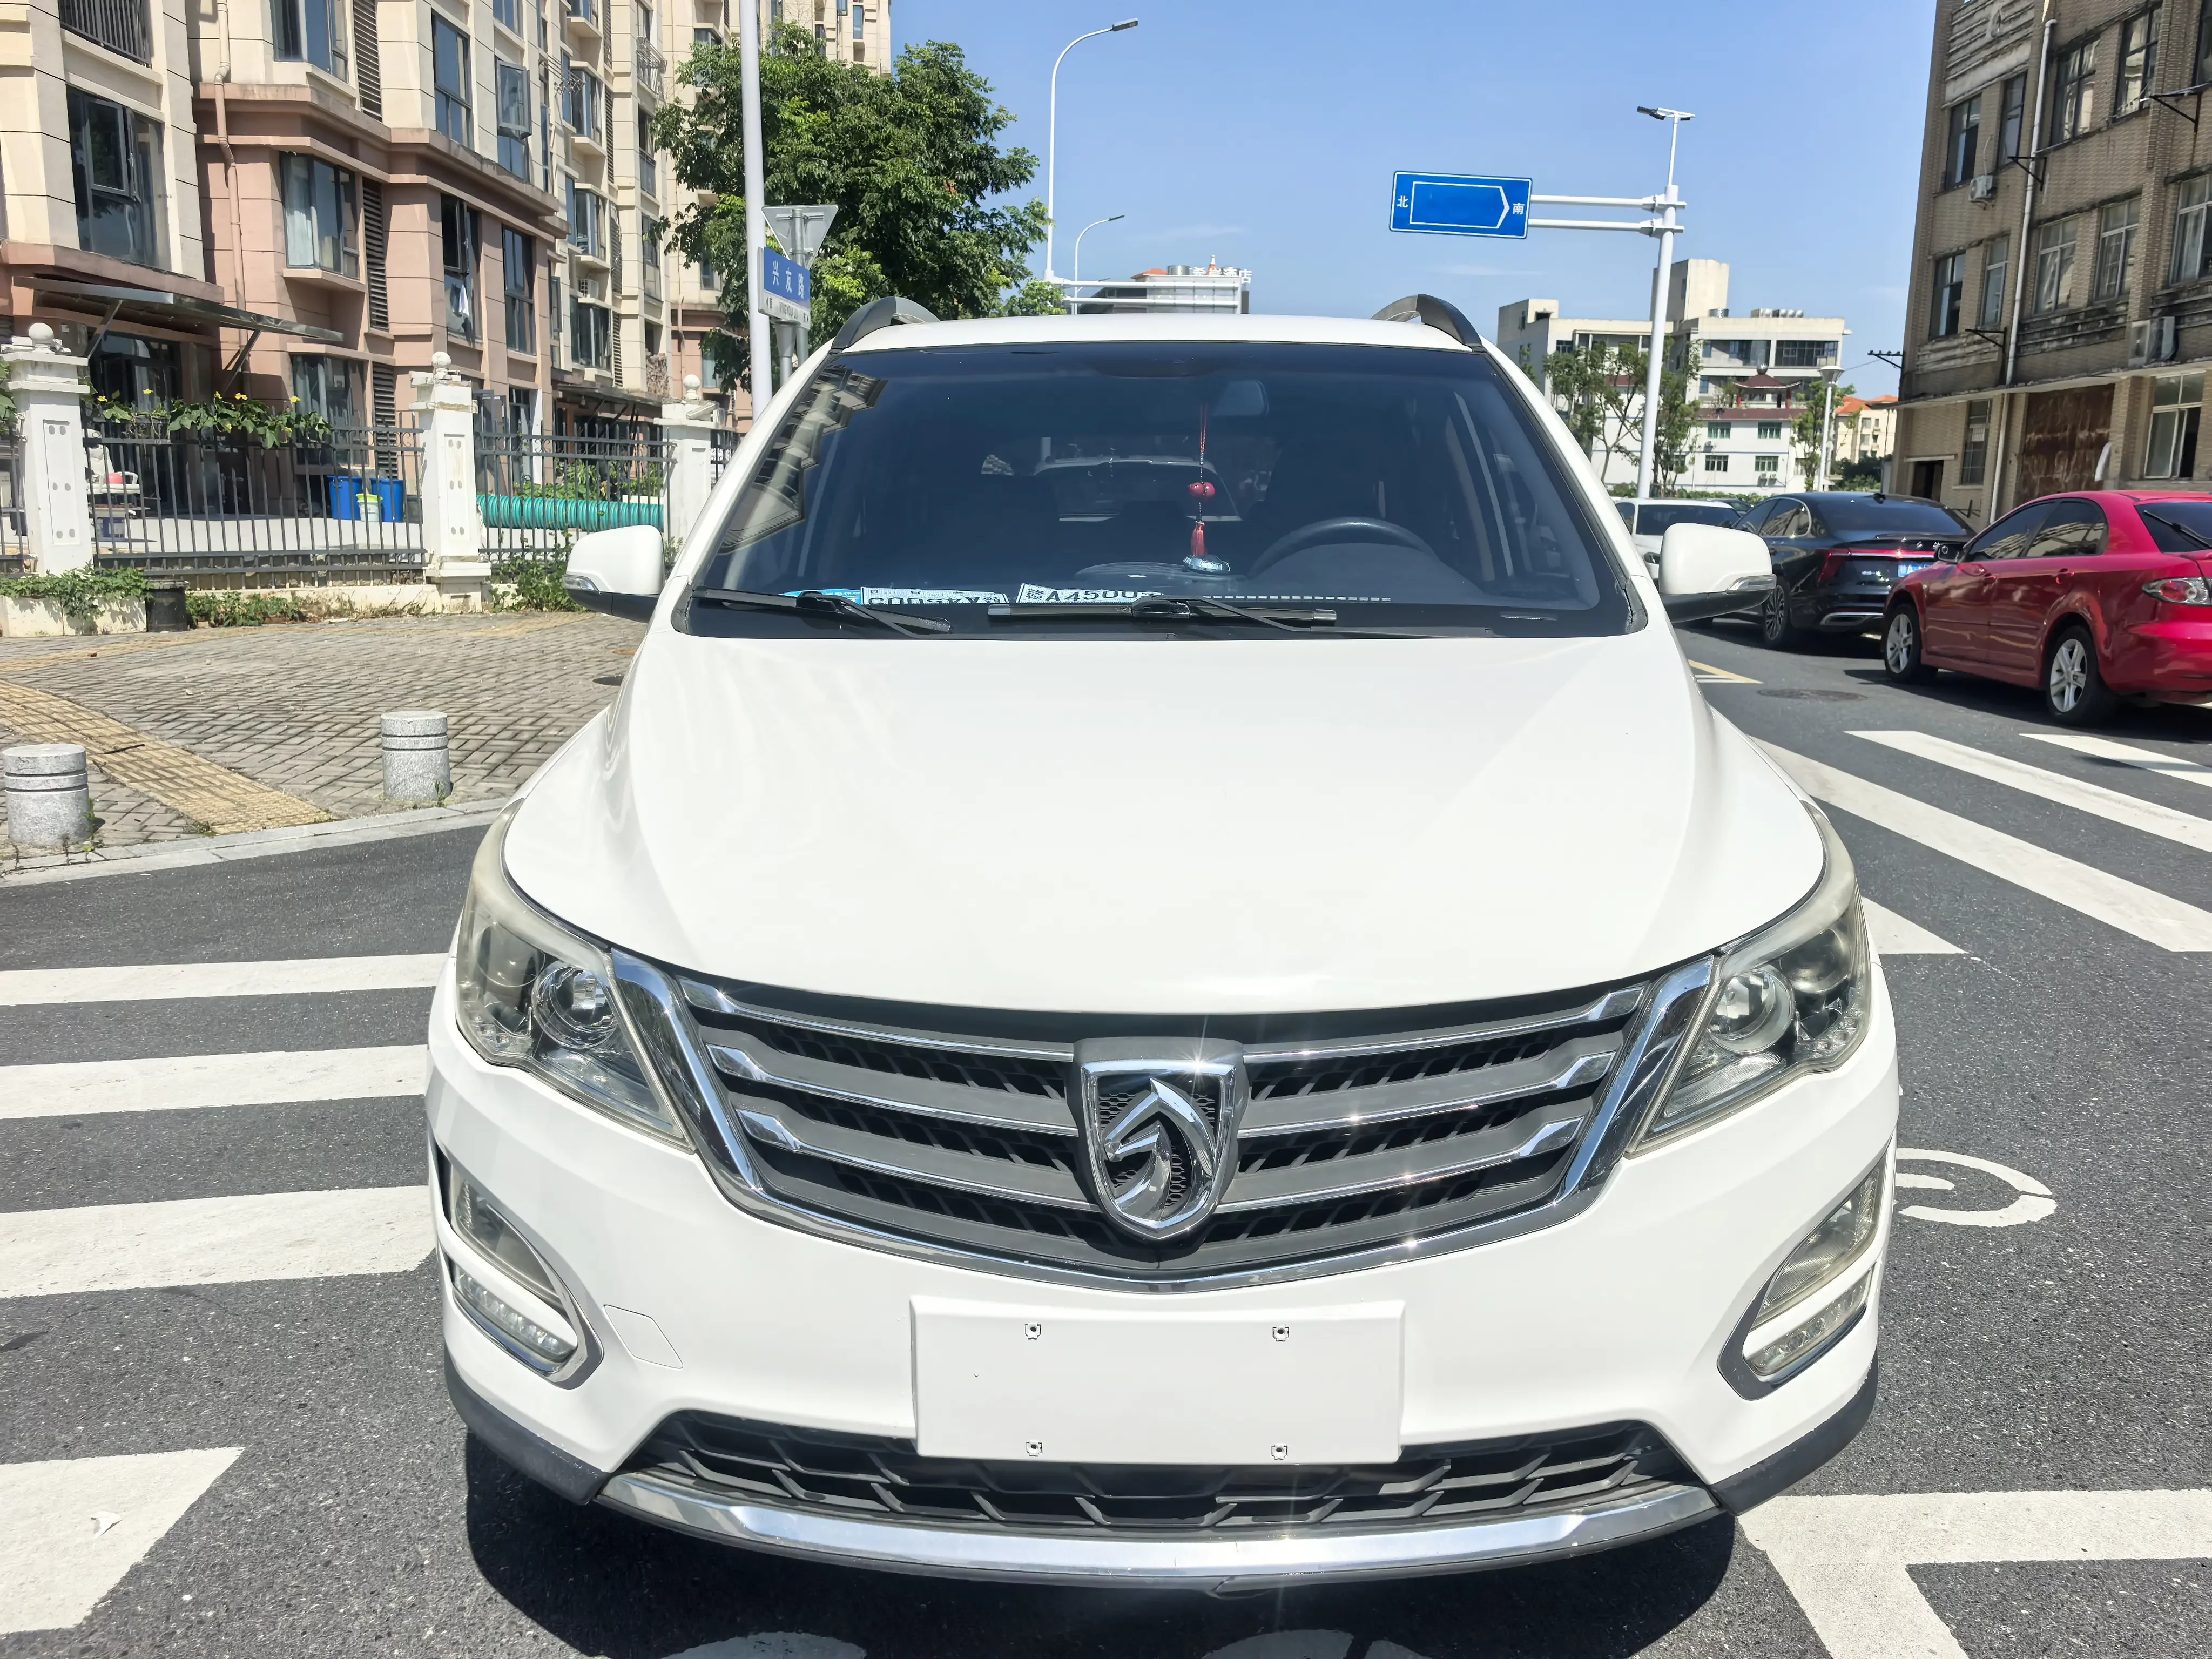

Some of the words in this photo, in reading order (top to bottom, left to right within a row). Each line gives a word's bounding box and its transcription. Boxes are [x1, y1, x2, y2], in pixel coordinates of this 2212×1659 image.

[1397, 195, 1409, 208] 北
[1513, 203, 1525, 215] 南
[772, 260, 805, 299] 兴友路
